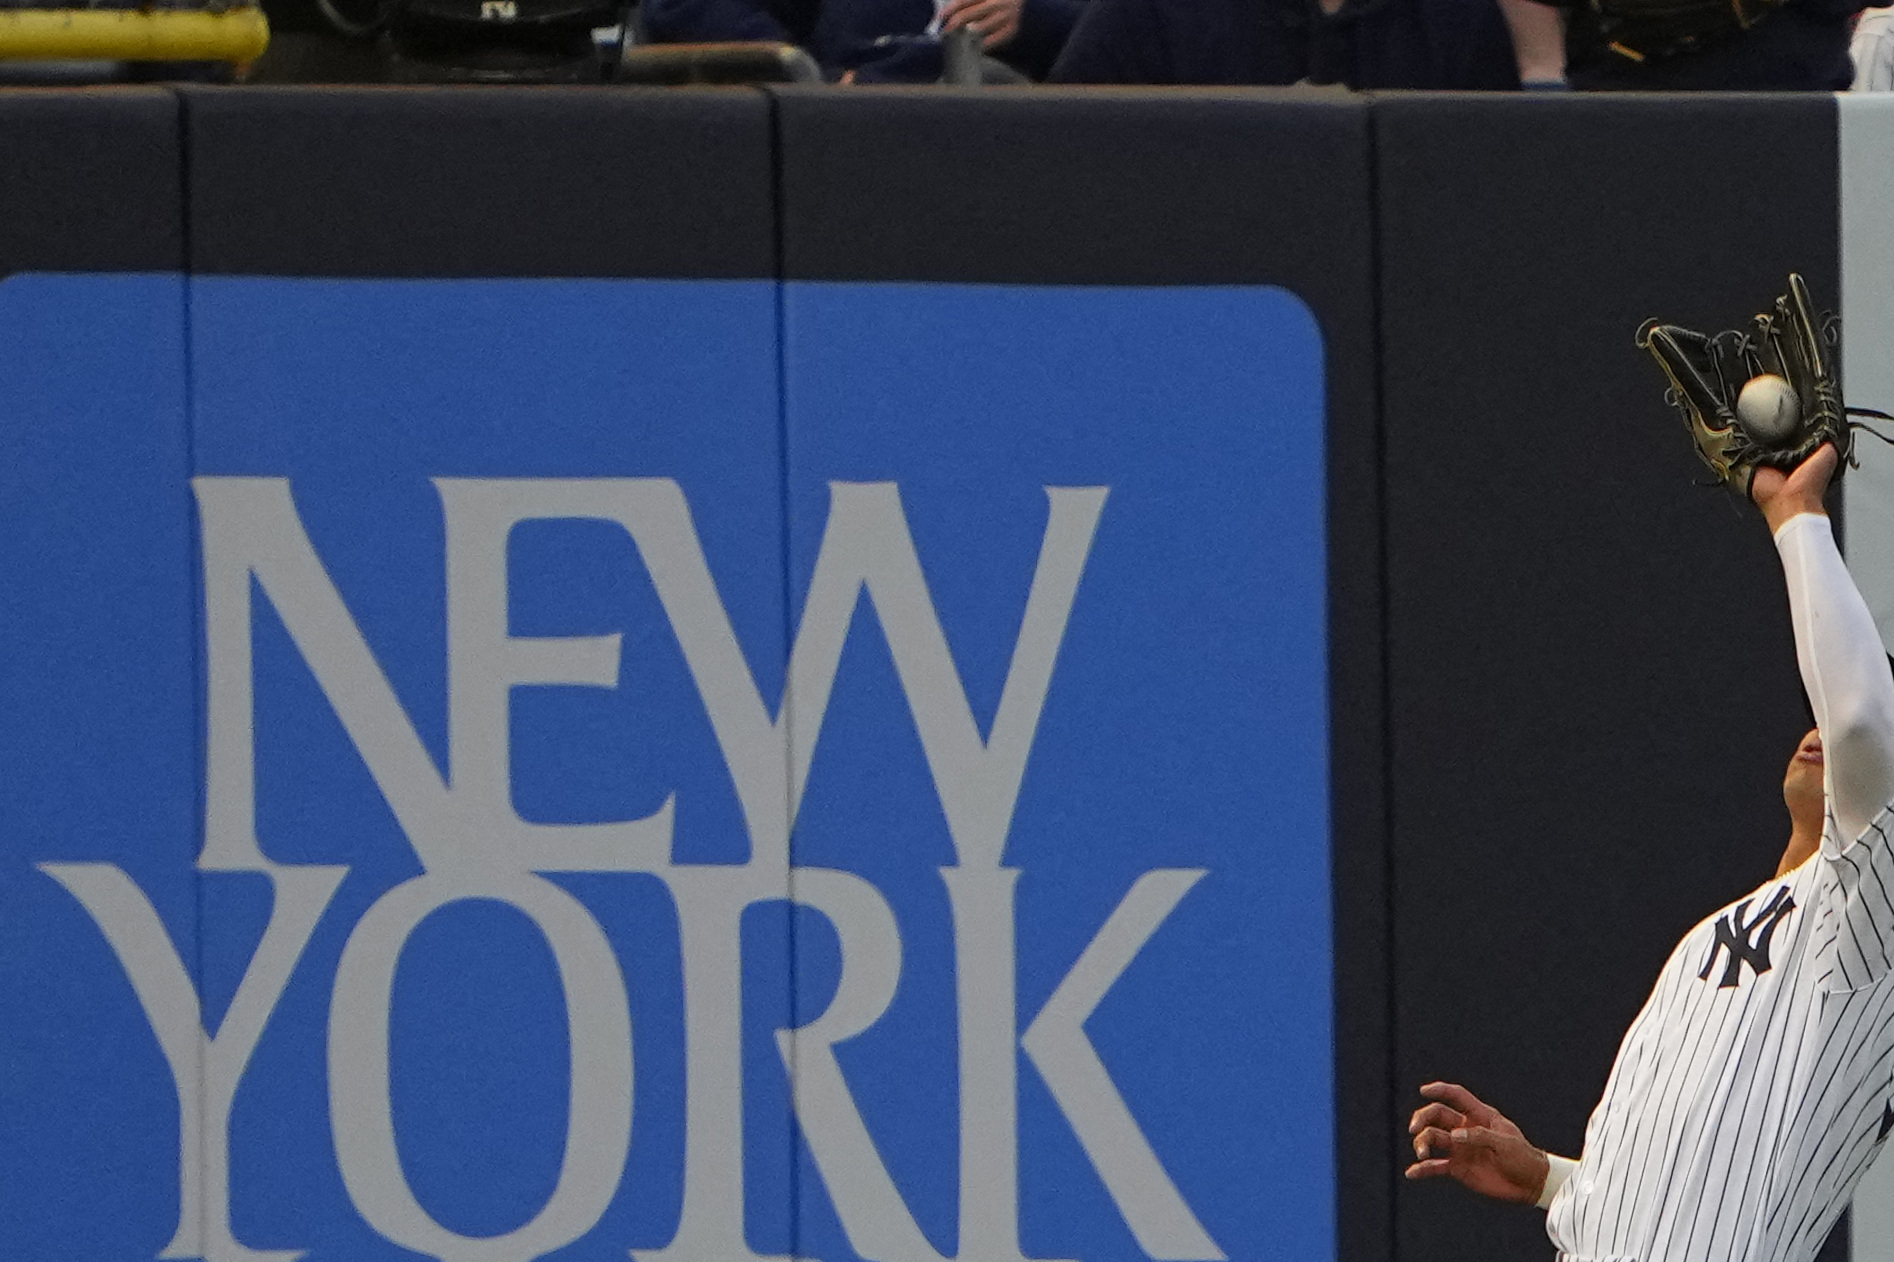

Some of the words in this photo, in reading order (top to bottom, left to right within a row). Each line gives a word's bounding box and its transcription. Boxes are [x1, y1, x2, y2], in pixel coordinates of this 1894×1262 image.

[190, 476, 1110, 870] NEW
[36, 862, 1228, 1262] YORK
[1698, 885, 1797, 989] NY
